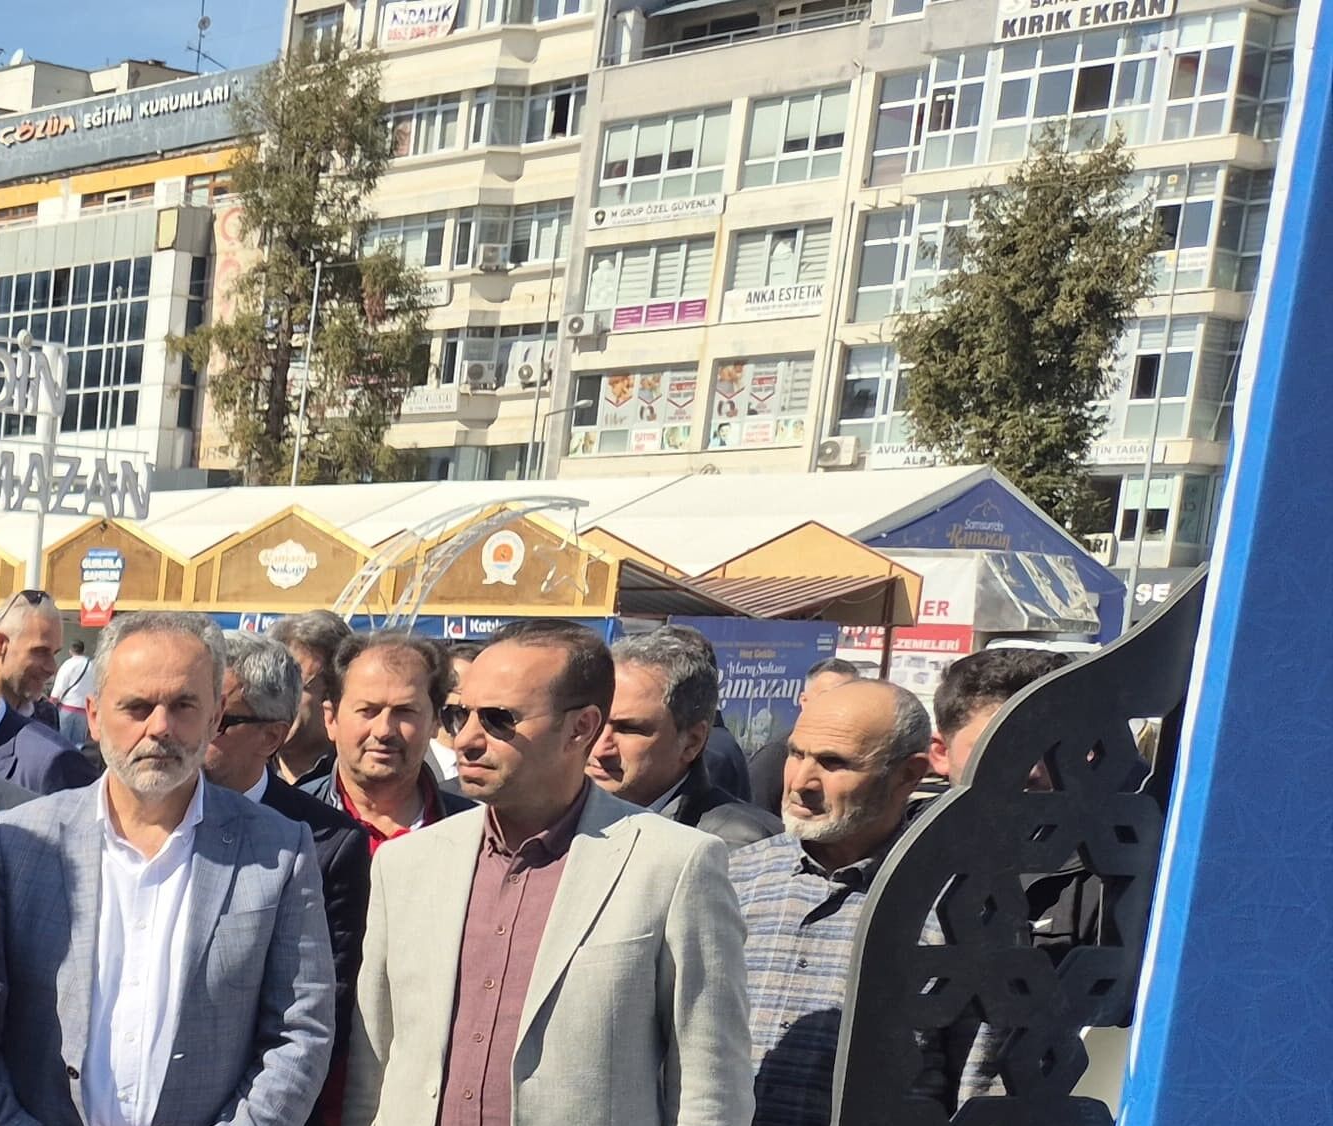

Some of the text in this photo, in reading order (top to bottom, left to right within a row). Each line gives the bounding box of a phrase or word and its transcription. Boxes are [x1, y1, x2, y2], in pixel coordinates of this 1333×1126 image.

[1001, 0, 1166, 39] KIRIK EKRAN
[83, 104, 133, 129] EĞİTİM
[138, 84, 231, 120] KURUMLARI
[646, 203, 668, 215] ÖZEL
[745, 284, 824, 304] ANKA ESTETİK
